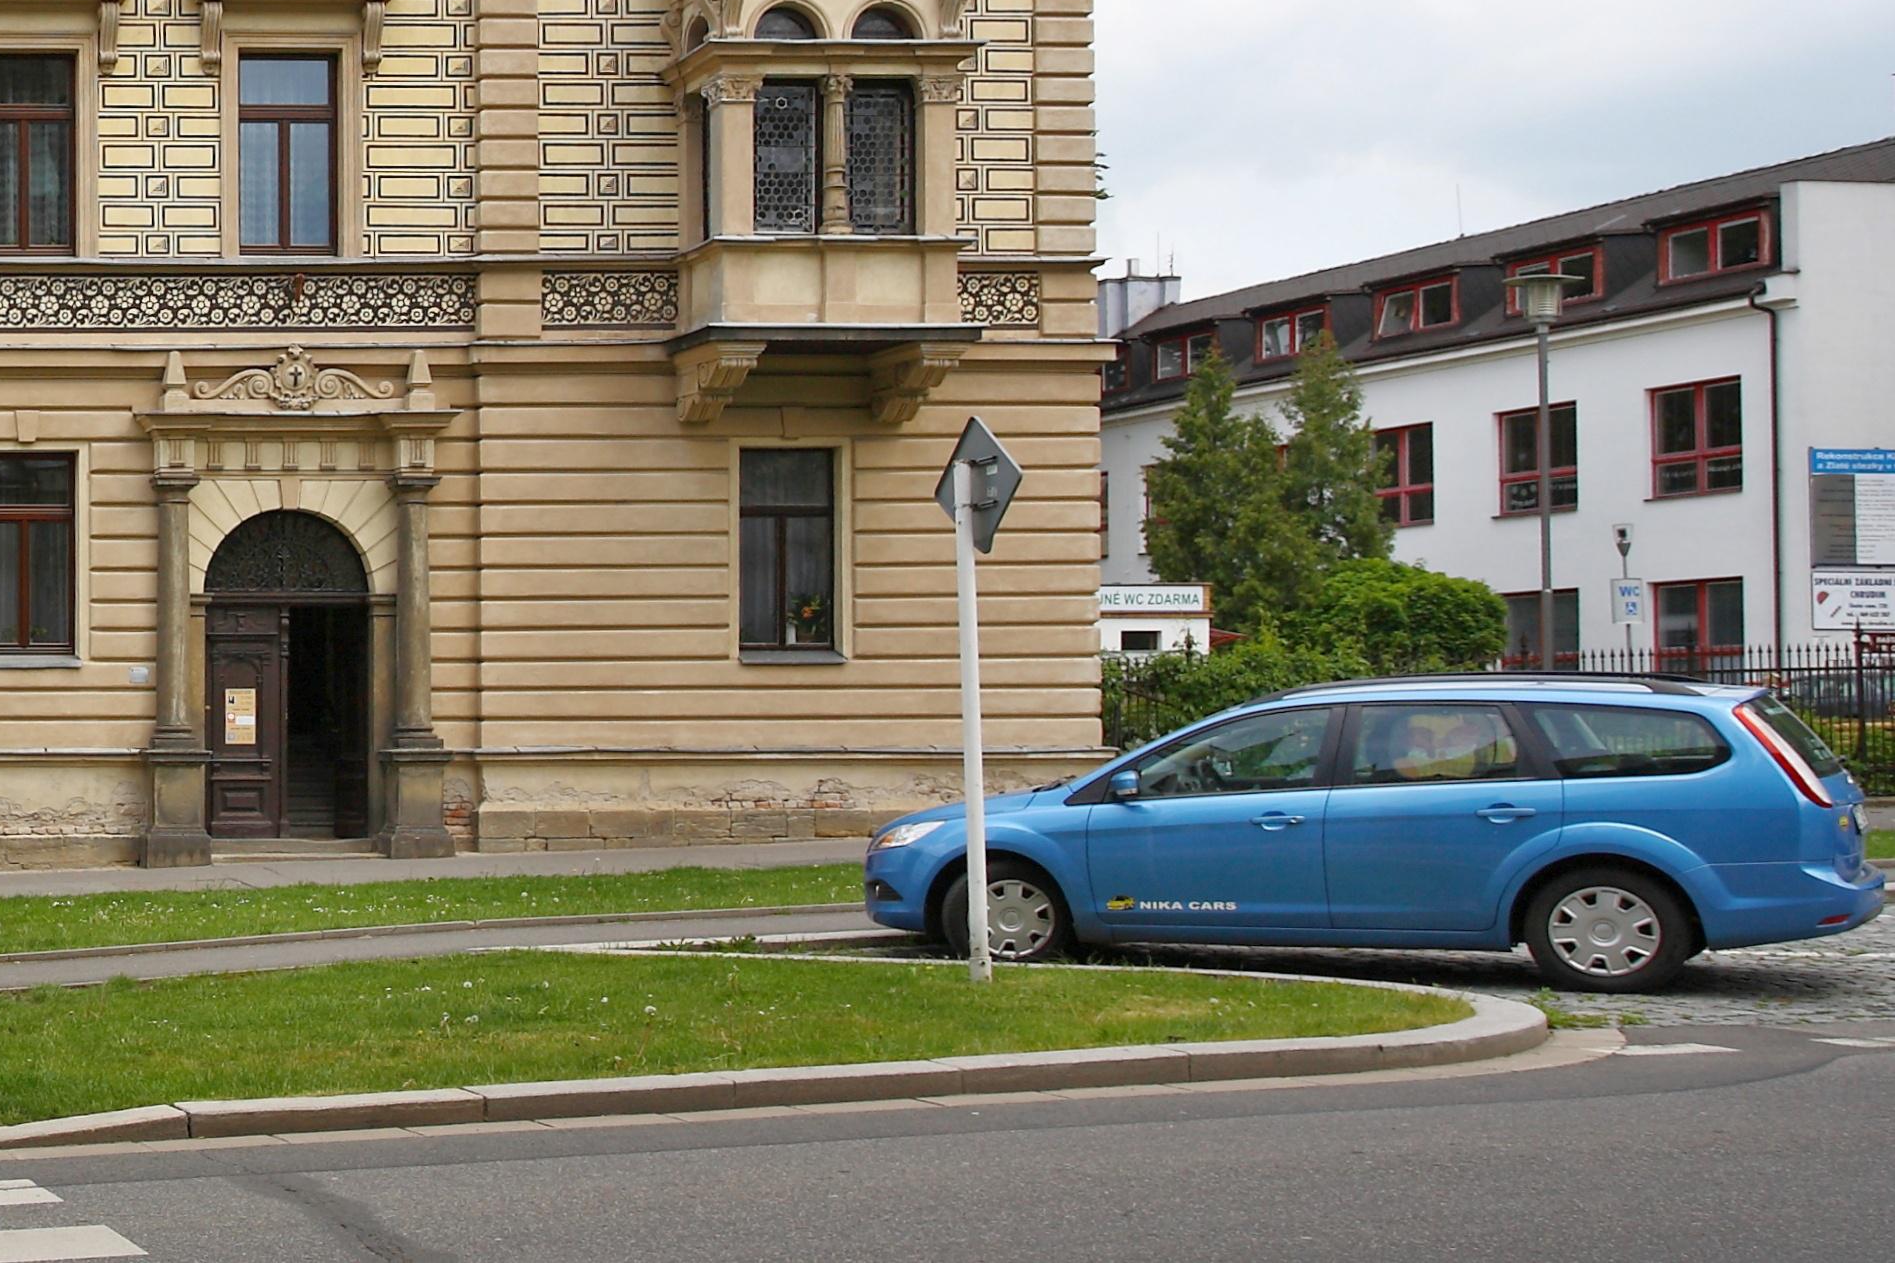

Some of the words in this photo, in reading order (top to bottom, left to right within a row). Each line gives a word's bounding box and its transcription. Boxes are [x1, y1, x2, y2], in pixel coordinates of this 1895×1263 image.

[1619, 586, 1640, 597] WC
[1124, 593, 1144, 605] WC
[1148, 593, 1200, 605] ZDARMA
[1139, 901, 1183, 910] NIKA
[1188, 901, 1238, 911] CARS
